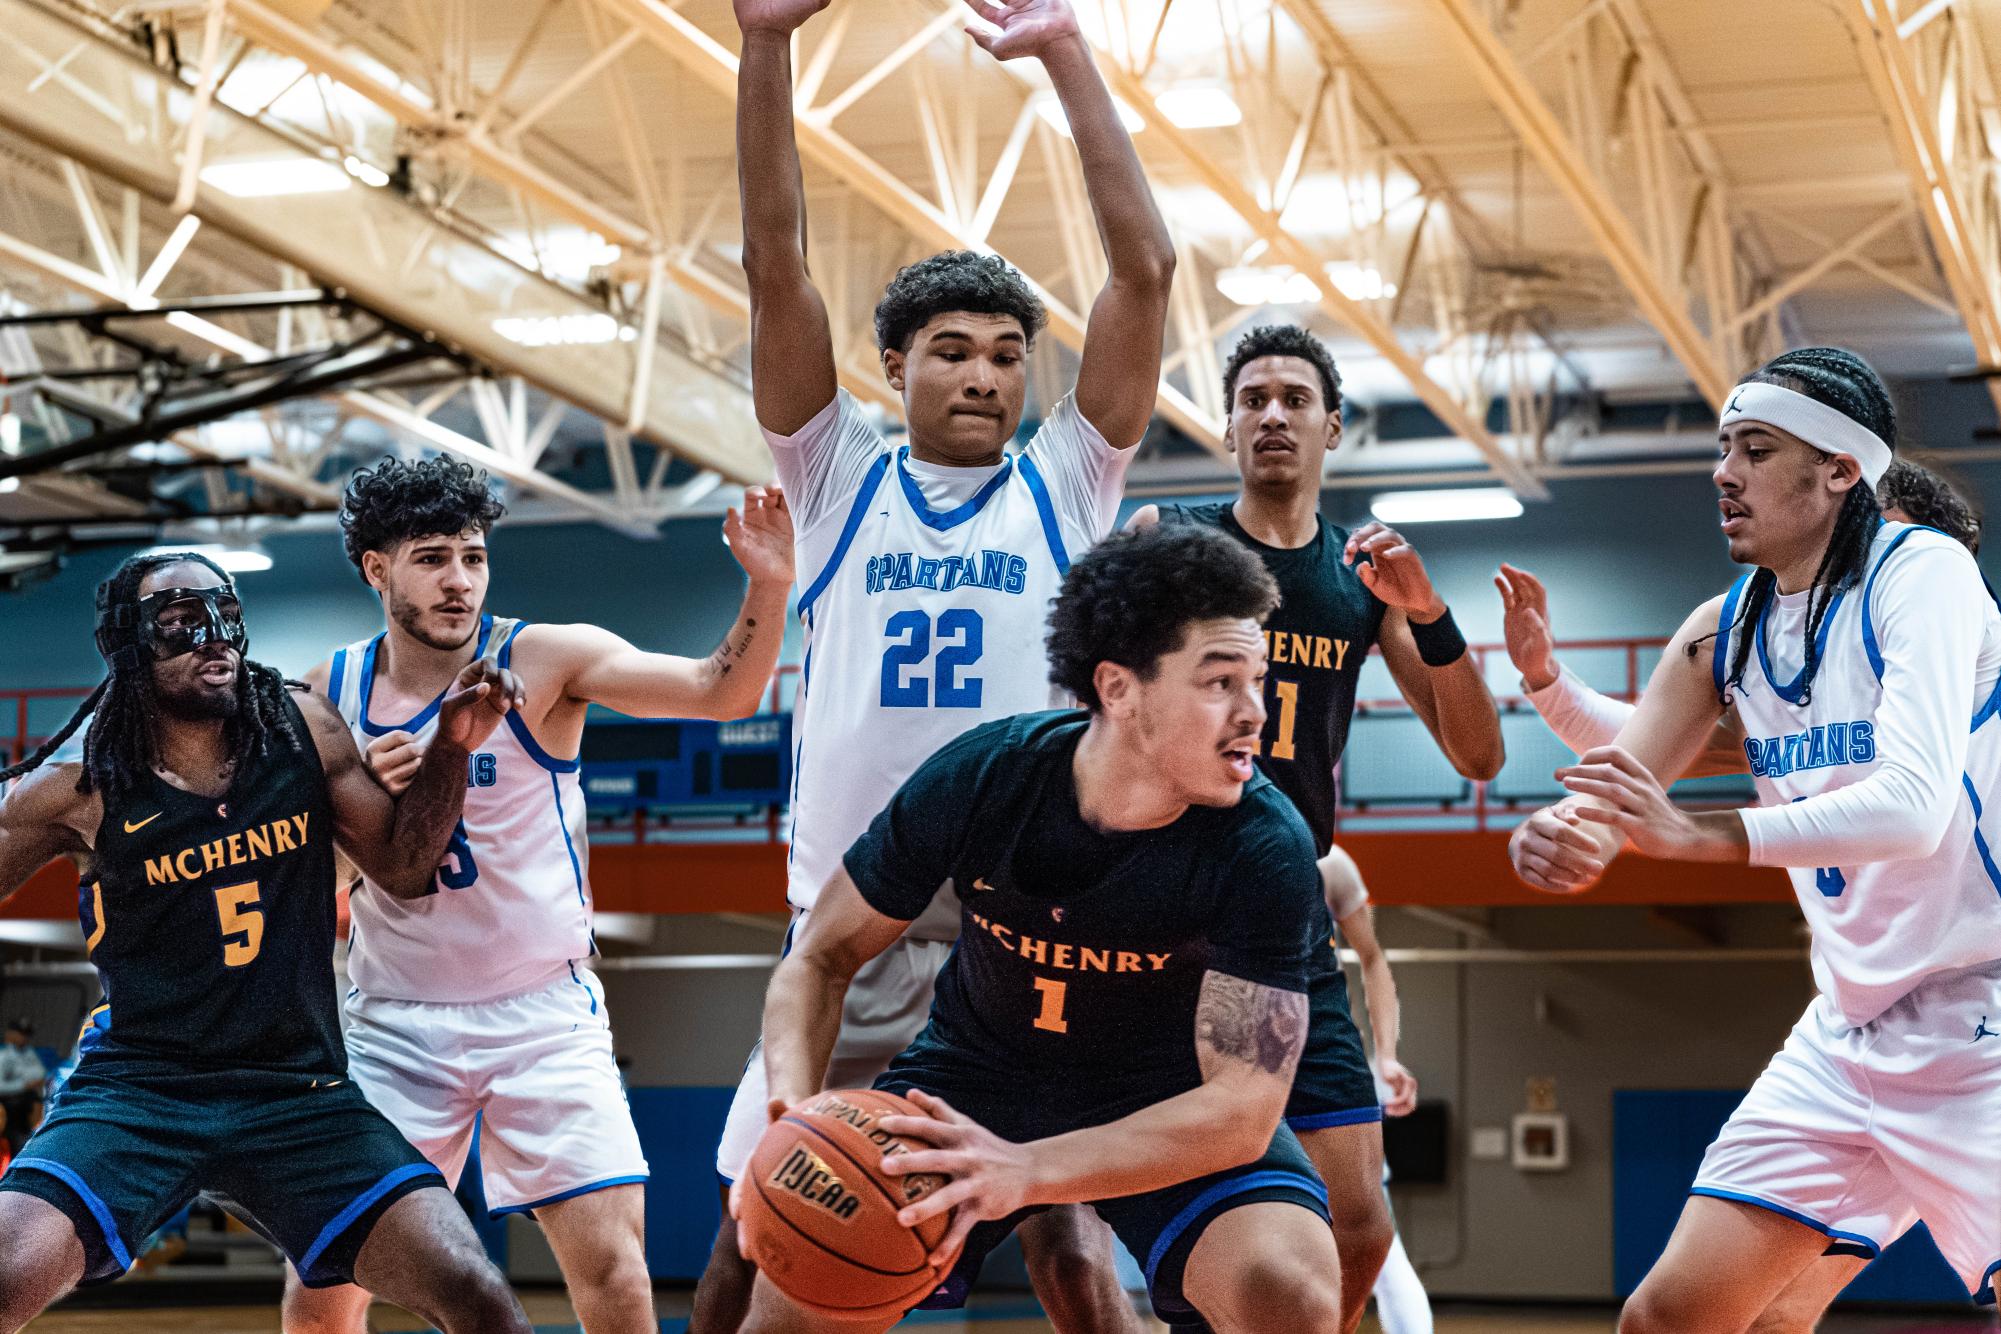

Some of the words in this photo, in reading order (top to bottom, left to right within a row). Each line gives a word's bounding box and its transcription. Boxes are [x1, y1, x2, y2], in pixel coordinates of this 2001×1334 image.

[866, 549, 1028, 596] SPARTANS
[880, 608, 984, 709] 22
[1263, 629, 1350, 671] ENRY
[143, 811, 309, 886] MCHENRY
[214, 880, 265, 967] 5
[1033, 976, 1068, 1034] 1
[805, 1095, 932, 1201] PALDIG
